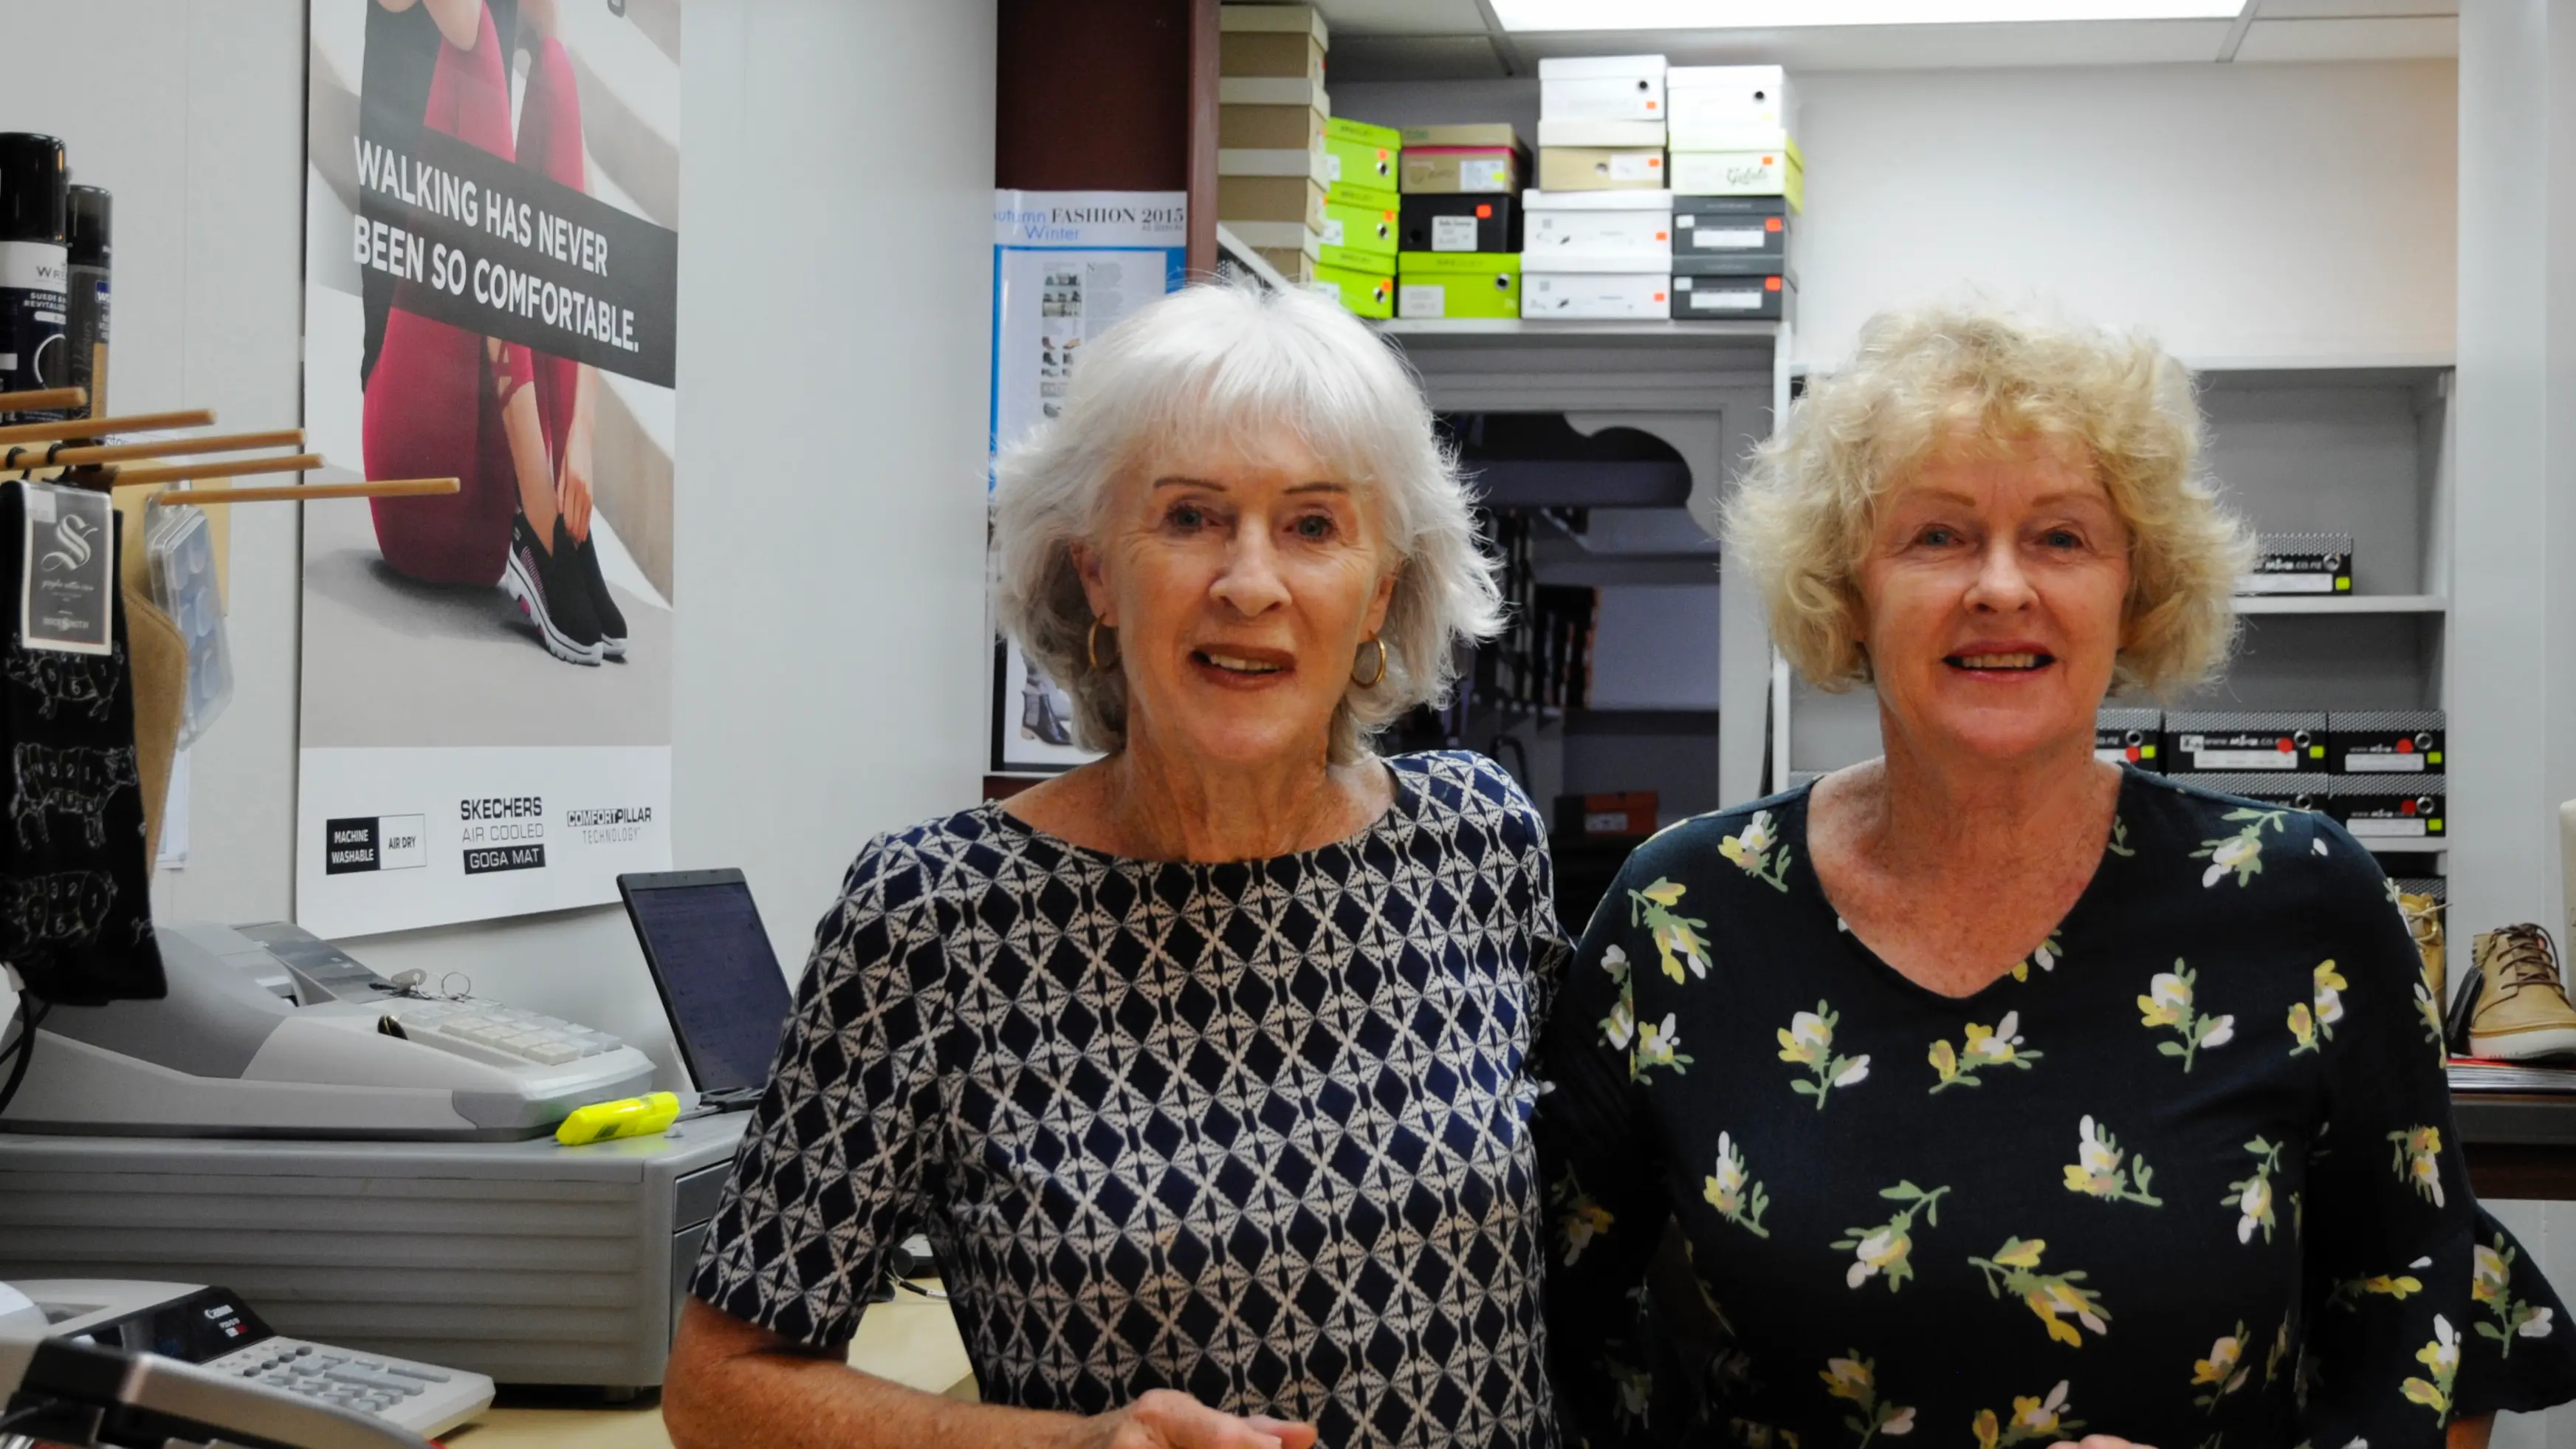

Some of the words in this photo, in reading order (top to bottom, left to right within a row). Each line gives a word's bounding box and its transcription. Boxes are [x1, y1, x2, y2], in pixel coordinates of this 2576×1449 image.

[354, 137, 478, 227] WALKING
[486, 189, 532, 247] HAS
[539, 210, 608, 276] NEVER
[1051, 208, 1134, 223] FASHION
[1142, 208, 1184, 223] 2015
[1025, 225, 1080, 241] Winter
[354, 215, 424, 283] BEEN
[432, 243, 466, 295] SO
[473, 258, 639, 352] COMFORTABLE.
[461, 797, 543, 821] SKECHERS
[334, 829, 369, 843] MACHINE
[462, 826, 484, 843] AIR
[490, 823, 544, 841] COOLED
[582, 827, 638, 844] TECHNOLOGY
[388, 837, 400, 849] AIR
[402, 836, 416, 849] DRY
[331, 849, 374, 864] WASHABLE
[470, 851, 509, 869] GOGA
[512, 848, 540, 865] MAT
